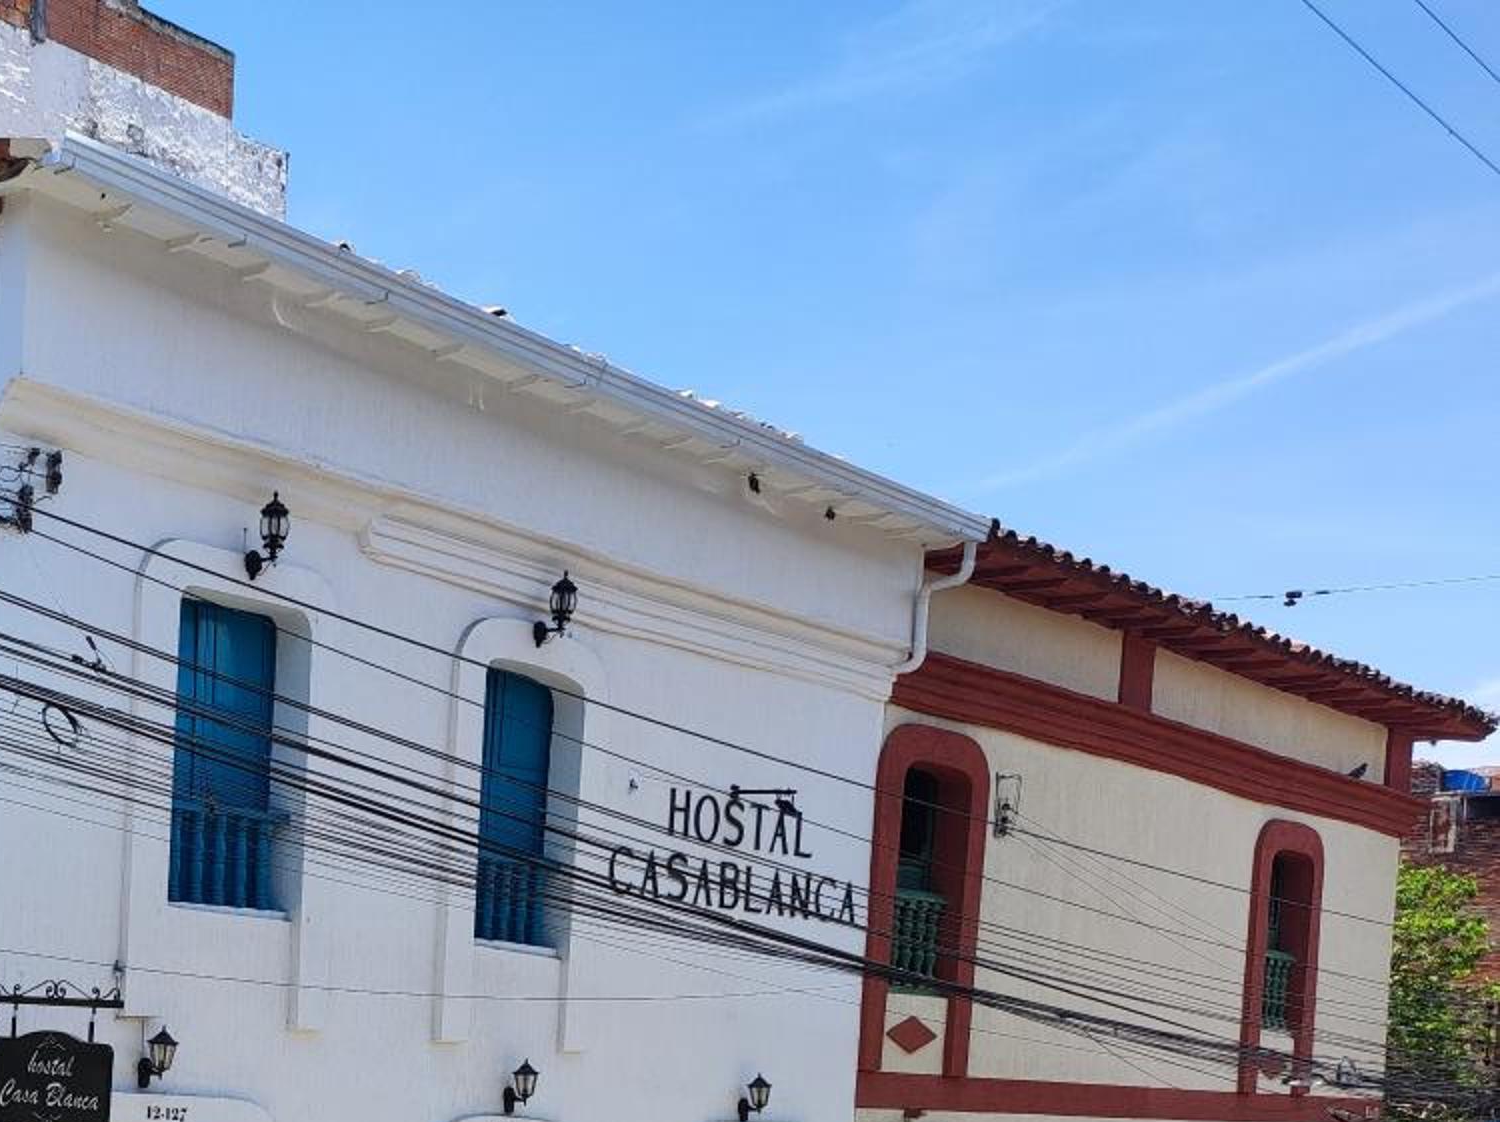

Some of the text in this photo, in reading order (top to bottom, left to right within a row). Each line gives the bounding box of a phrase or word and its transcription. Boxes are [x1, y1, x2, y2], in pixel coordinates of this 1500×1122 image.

[669, 788, 812, 859] HOSTAL
[608, 846, 855, 926] CASABLANCA
[27, 1050, 75, 1077] hostal
[0, 1078, 99, 1111] Casa Blanca
[146, 1105, 188, 1122] 12-127
